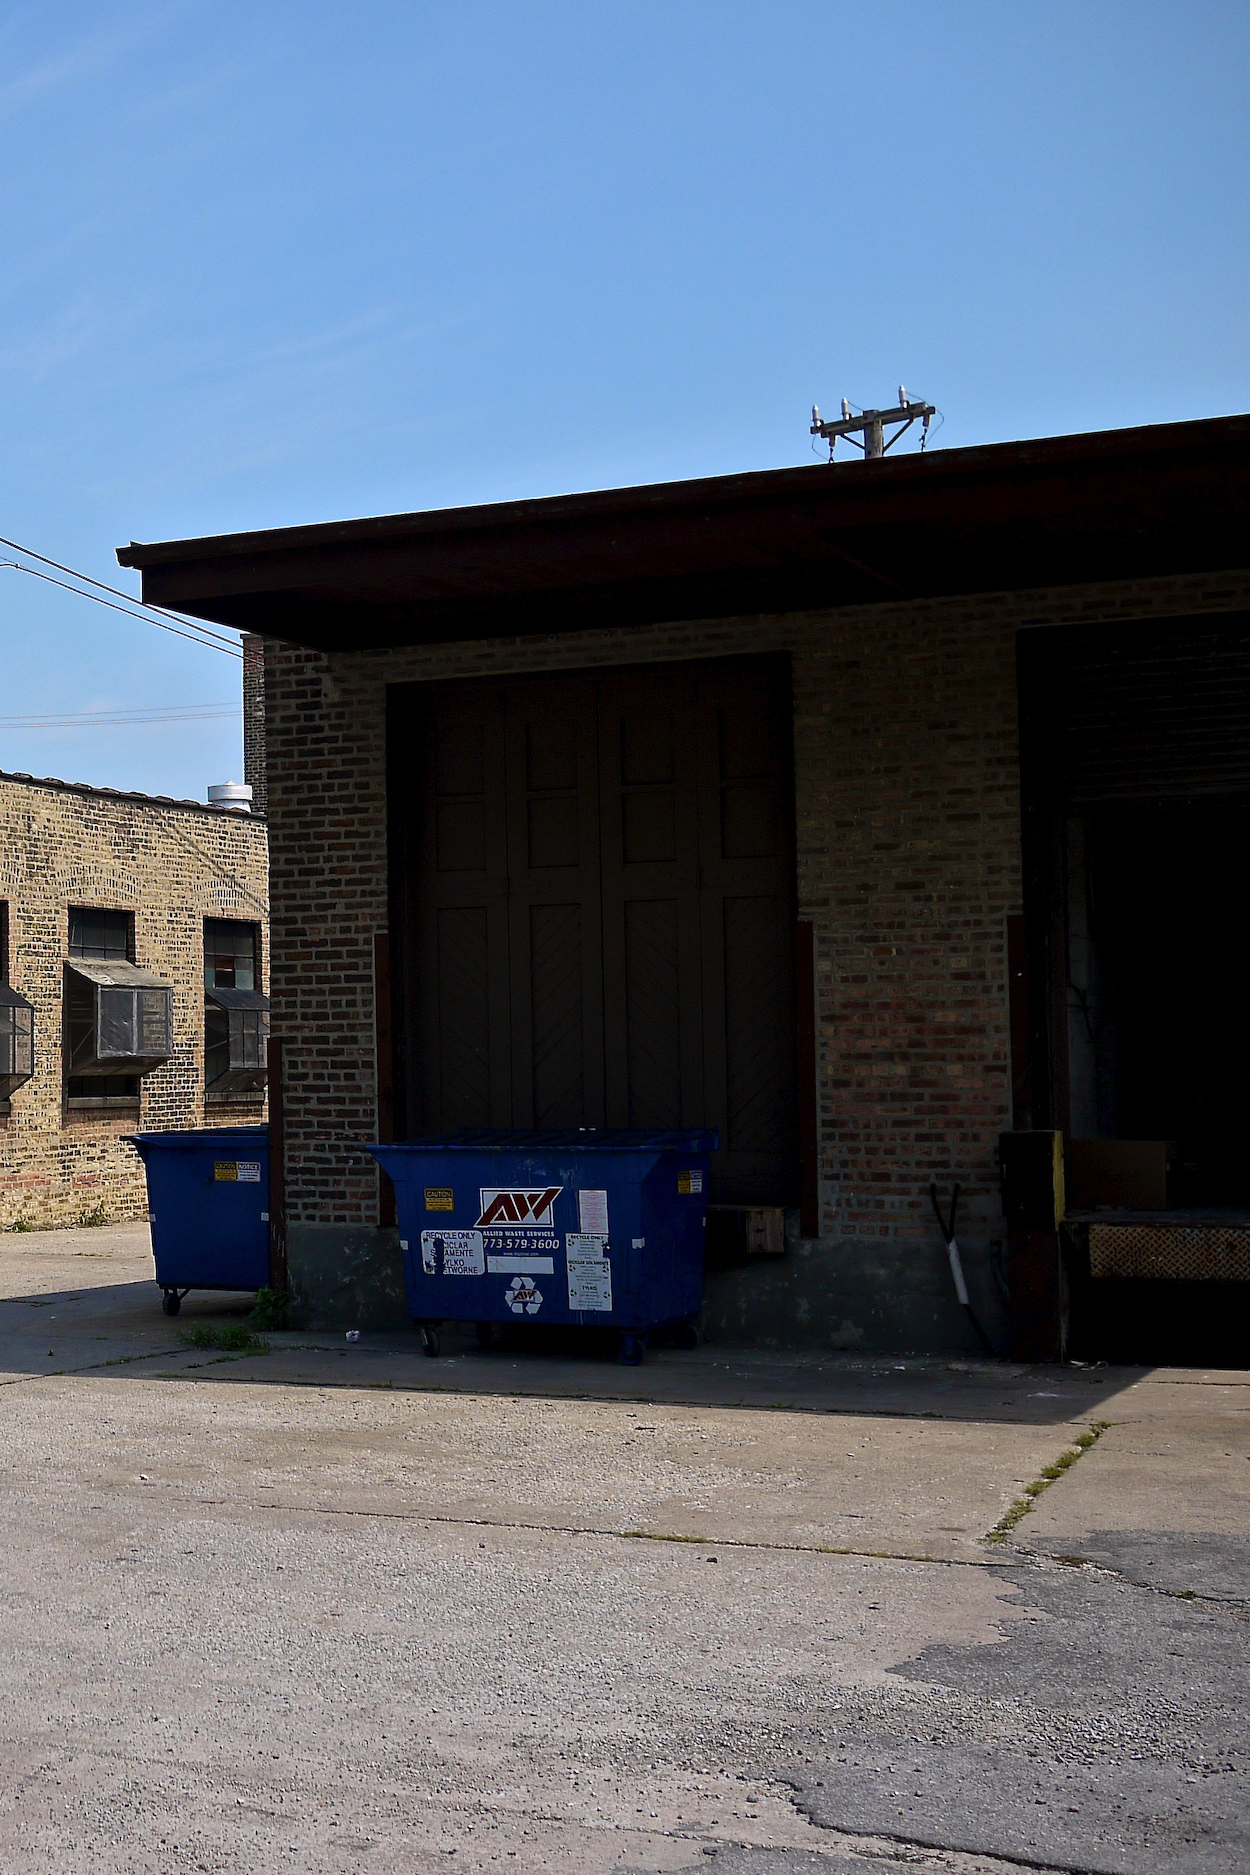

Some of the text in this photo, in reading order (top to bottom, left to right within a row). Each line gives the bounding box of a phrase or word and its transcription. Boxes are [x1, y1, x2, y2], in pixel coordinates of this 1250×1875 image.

[474, 1187, 564, 1227] AW
[426, 1231, 476, 1240] RECYCLE ONLY
[483, 1238, 560, 1249] 773-579-3600
[430, 1248, 474, 1257] SAMENTE
